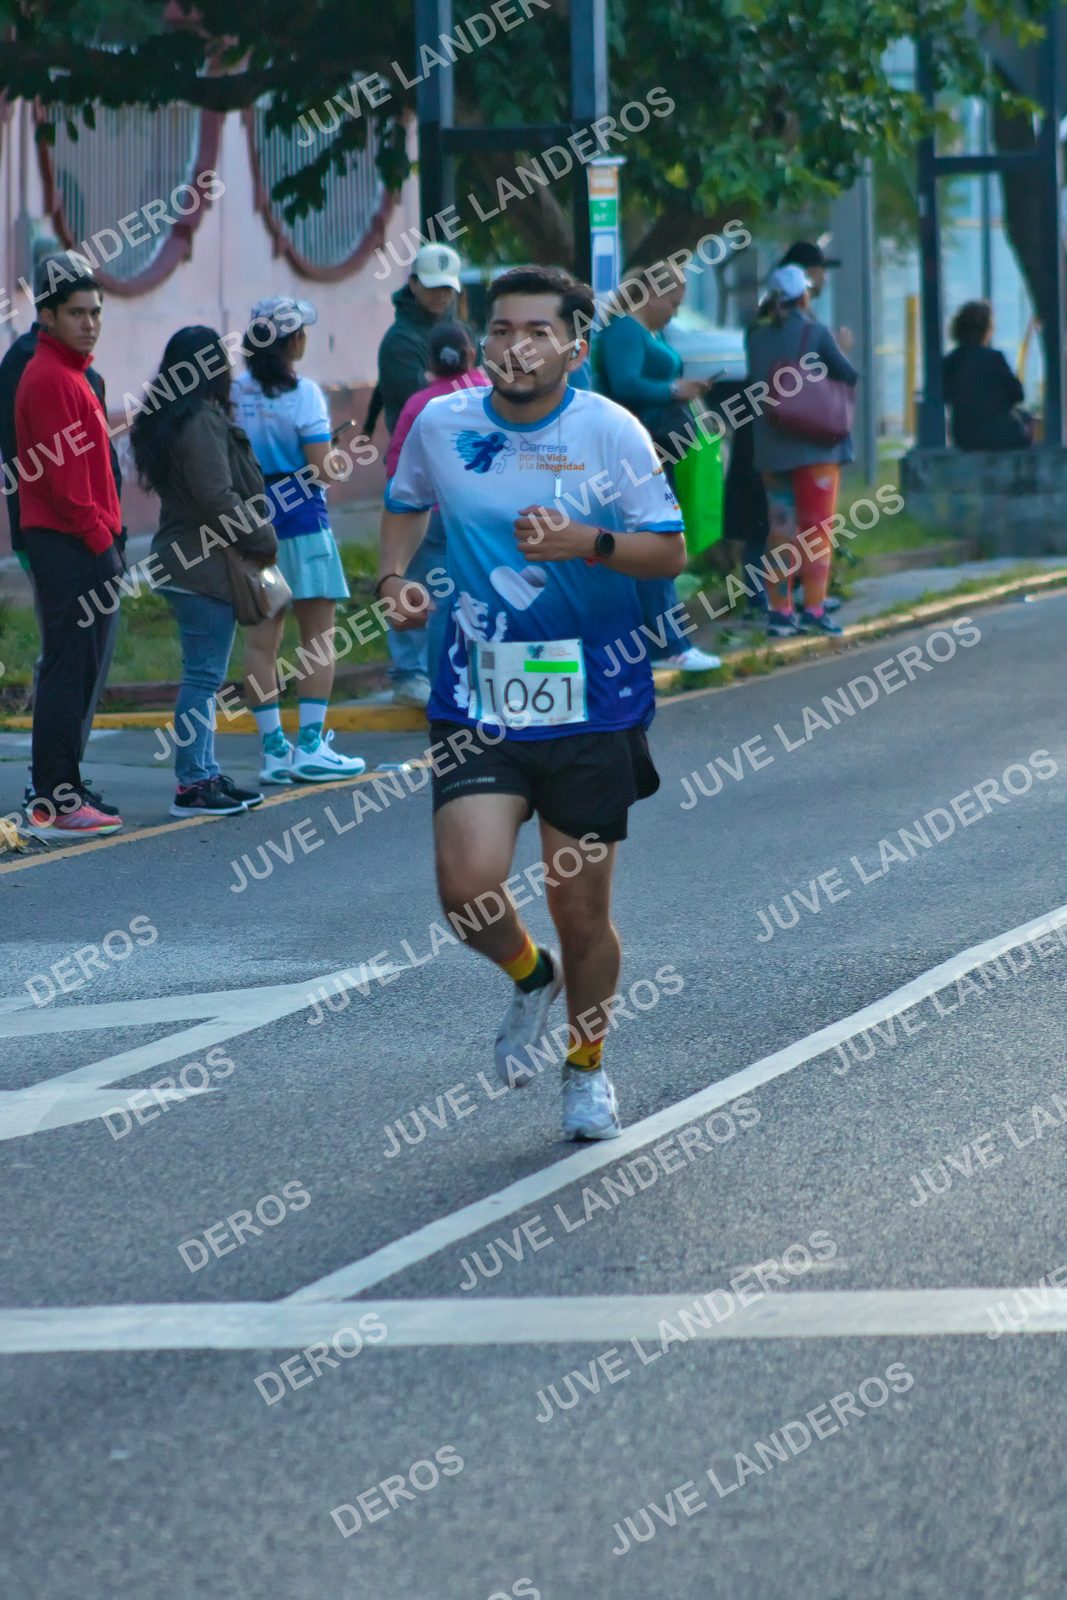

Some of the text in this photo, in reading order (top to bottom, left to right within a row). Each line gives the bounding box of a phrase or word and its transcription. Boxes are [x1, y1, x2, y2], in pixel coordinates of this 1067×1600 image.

[520, 441, 568, 453] Carrera
[547, 453, 567, 462] Vida
[485, 677, 572, 714] 1061
